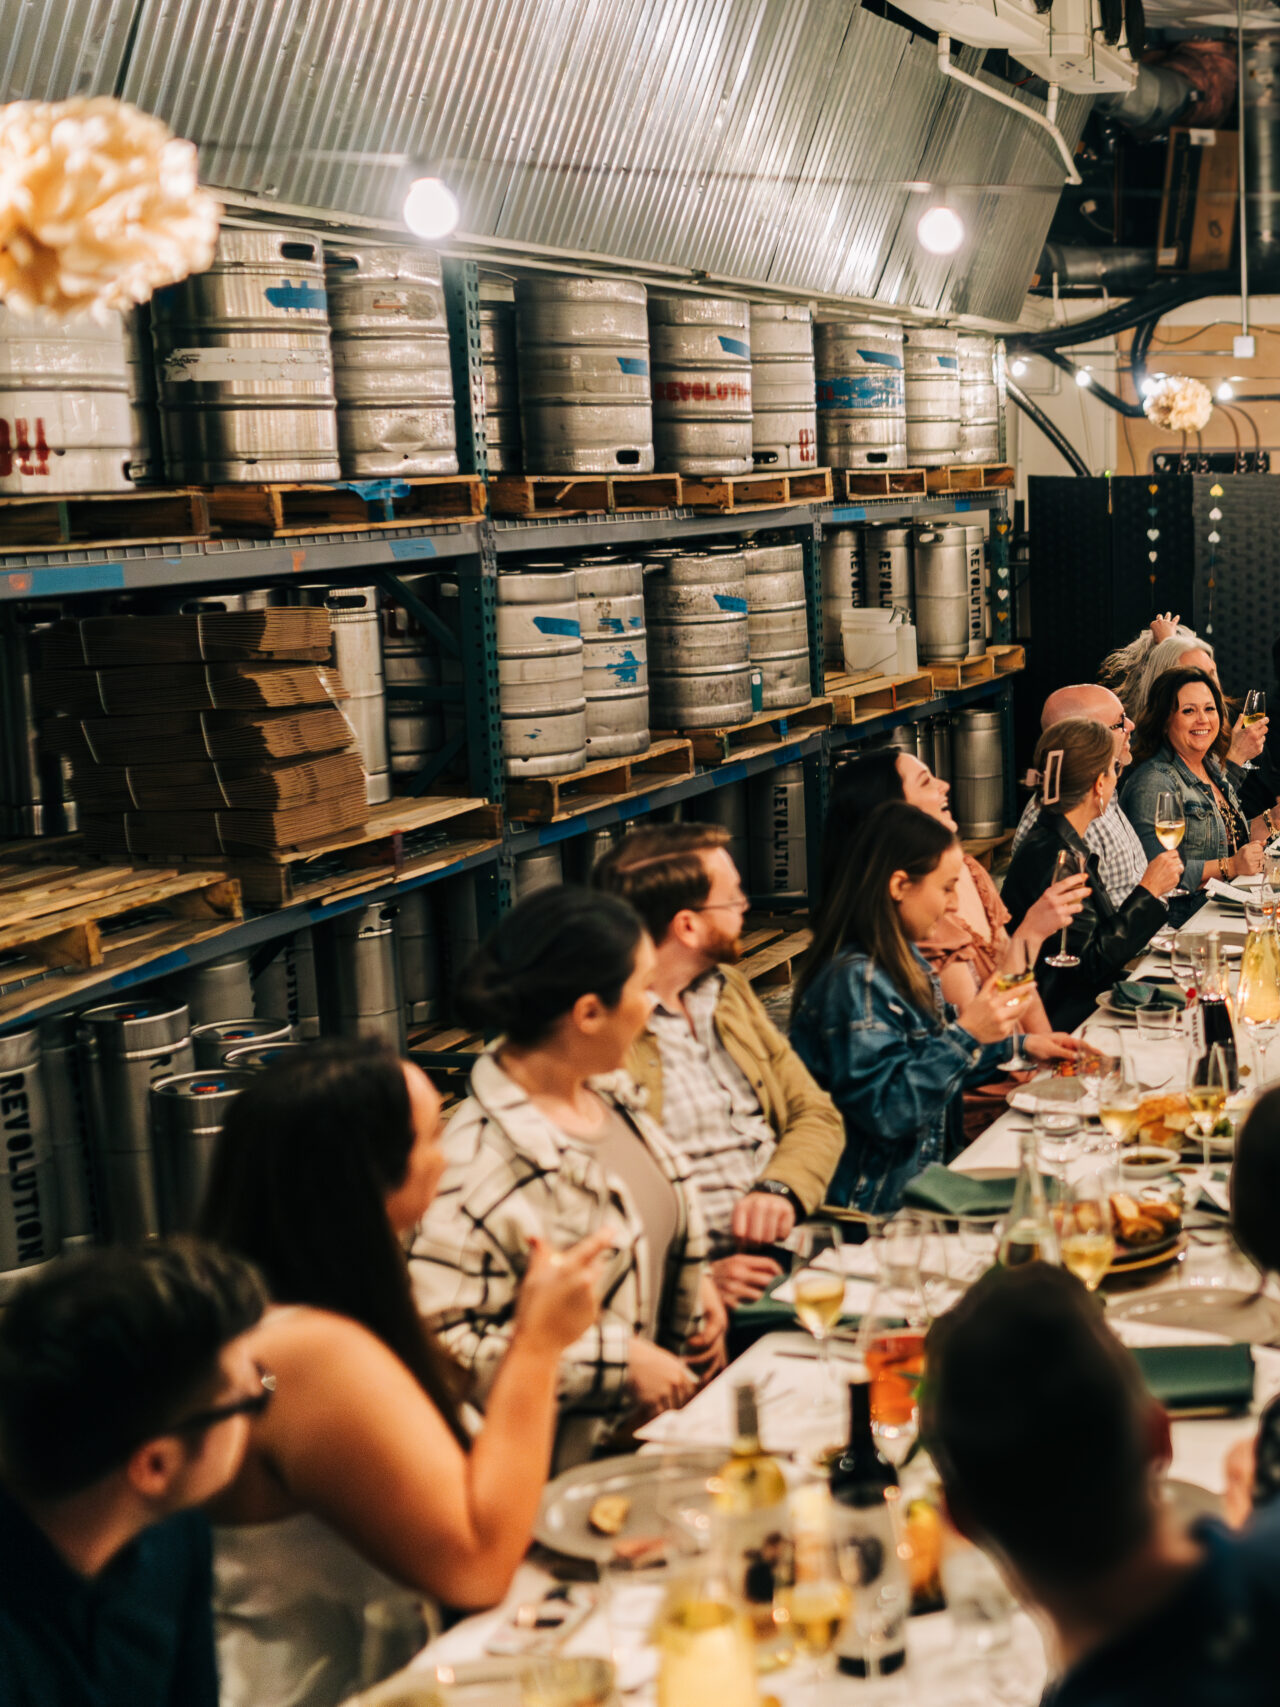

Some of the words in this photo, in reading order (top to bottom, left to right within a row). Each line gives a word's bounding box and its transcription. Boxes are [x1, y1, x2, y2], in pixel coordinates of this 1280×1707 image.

[970, 547, 982, 640] REVOLUTION
[773, 786, 789, 889] REVOLUTION
[0, 1072, 44, 1263] REVOLUTION
